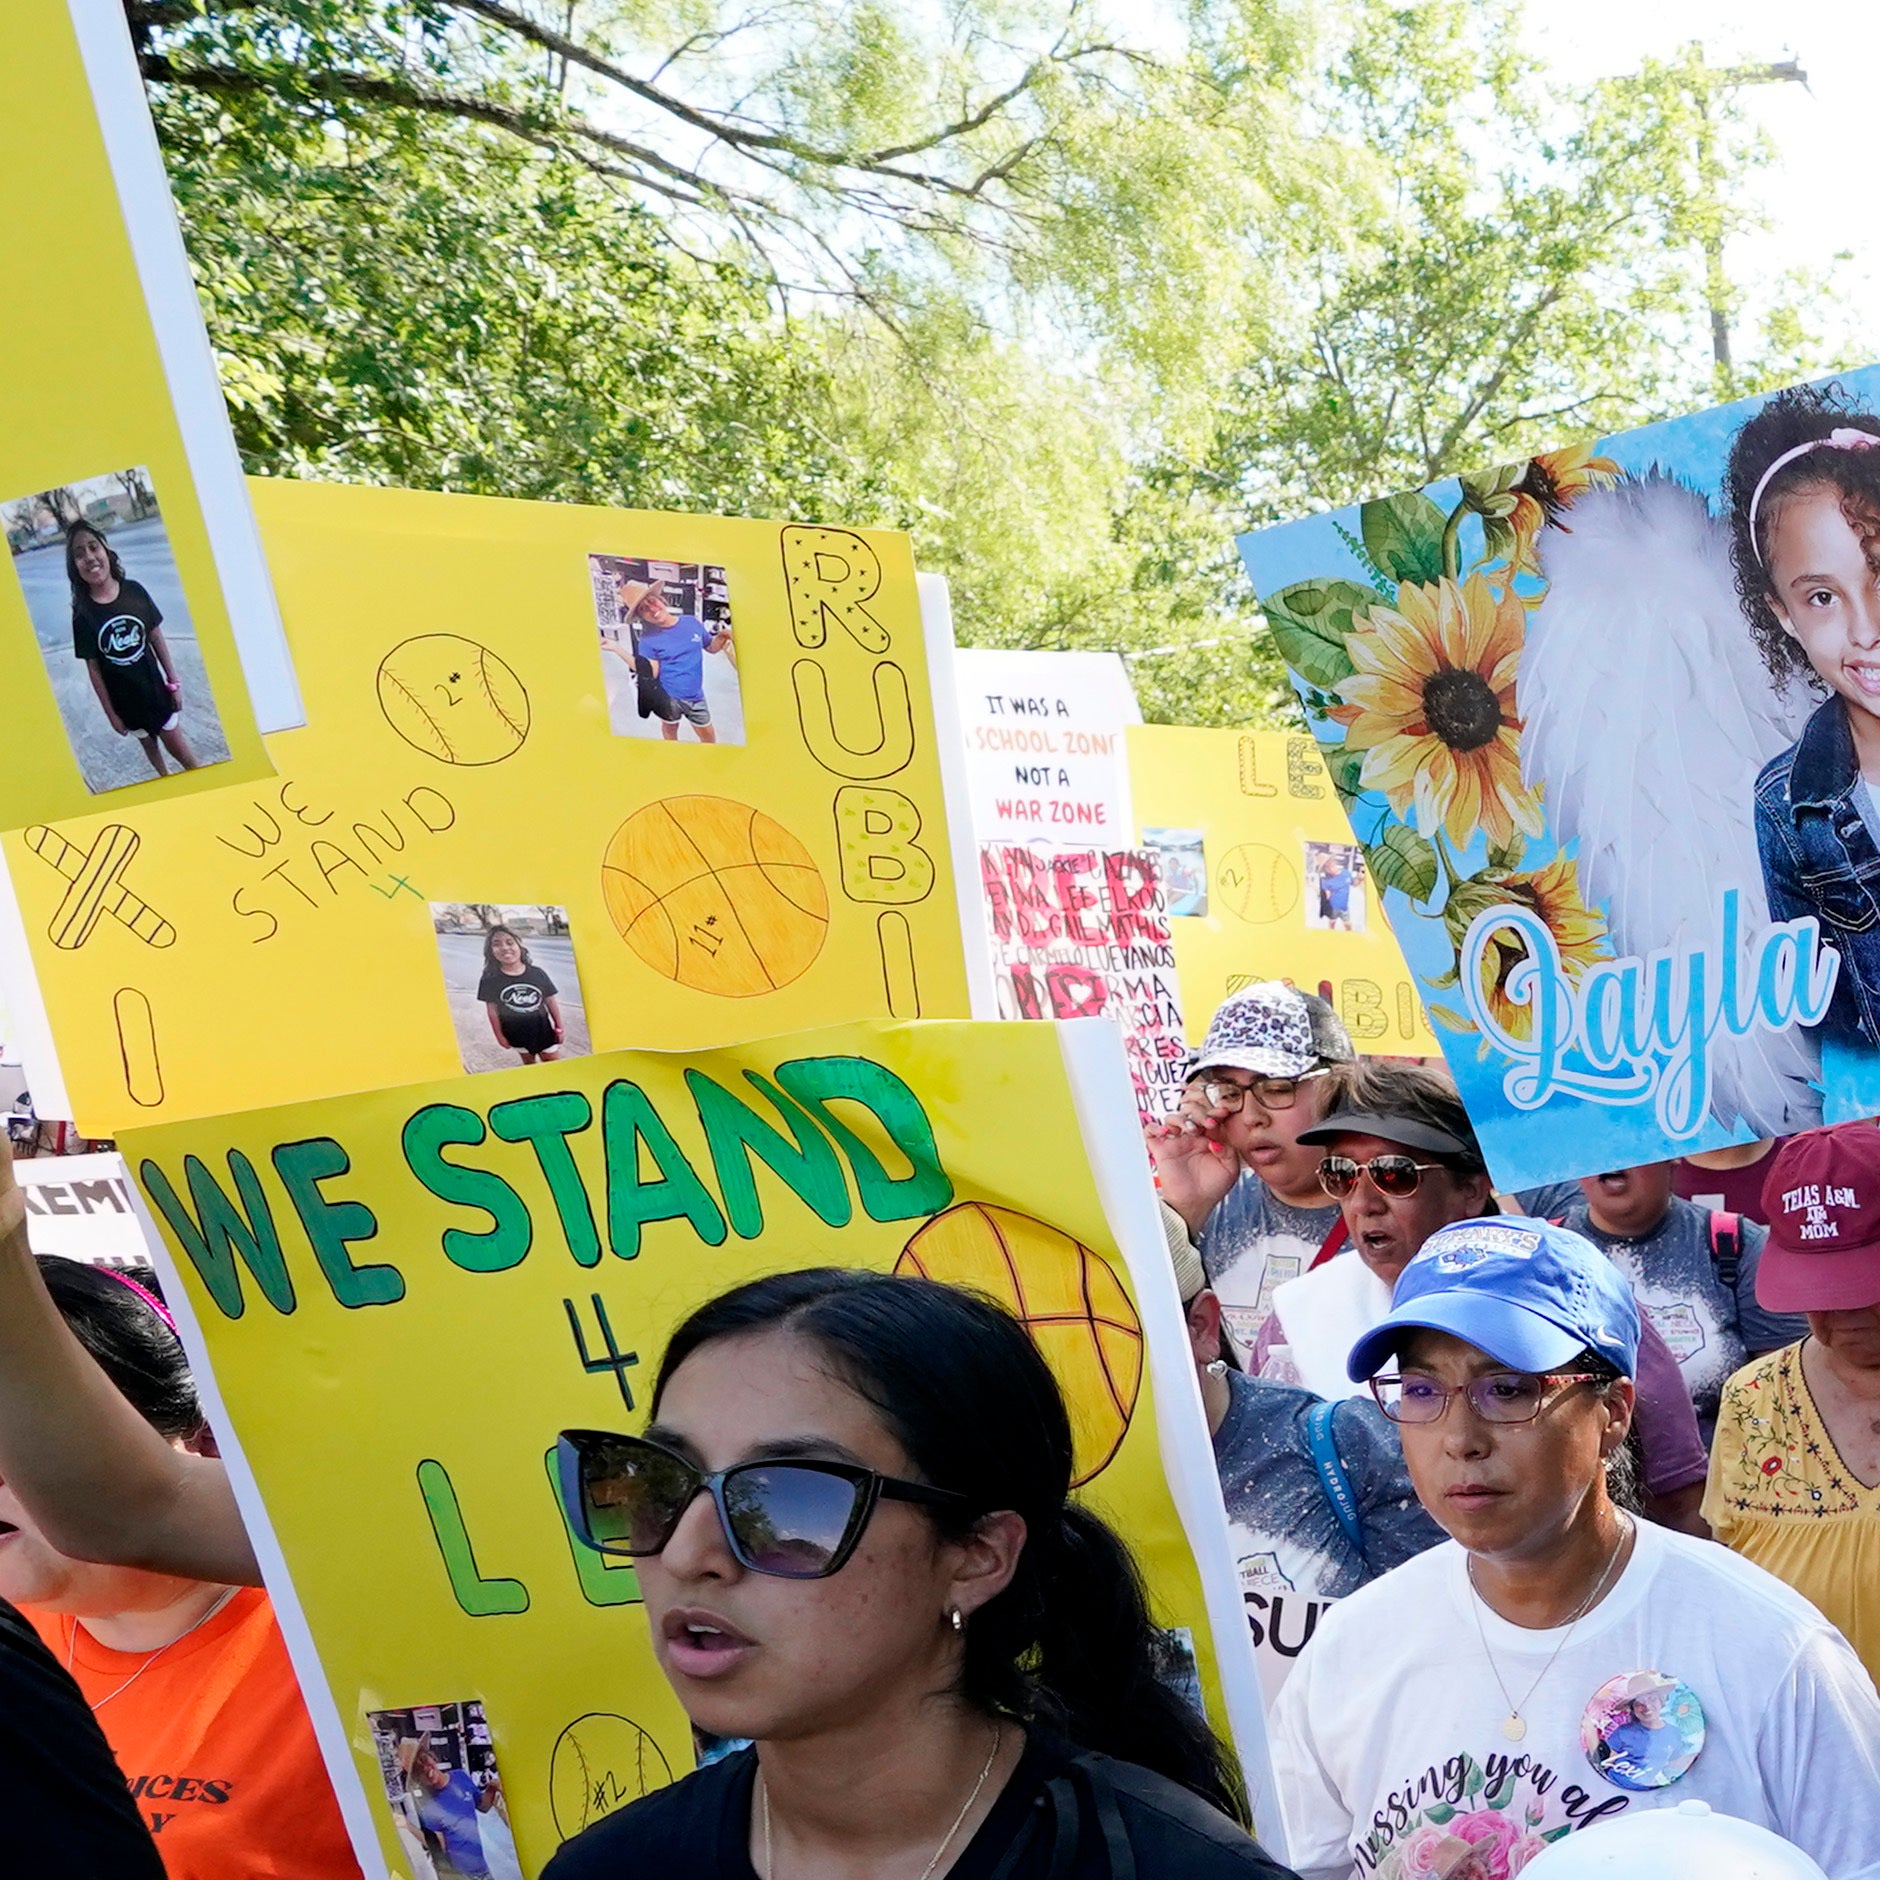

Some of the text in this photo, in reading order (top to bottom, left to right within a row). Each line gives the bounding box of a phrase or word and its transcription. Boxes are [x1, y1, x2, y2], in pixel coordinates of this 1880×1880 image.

[985, 695, 1069, 717] IT WAS A
[976, 727, 1057, 753] SCHOOL
[1016, 767, 1070, 786] NOT A
[216, 782, 334, 858] WE
[996, 799, 1107, 824] WAR ZONE
[233, 787, 456, 943] STAND
[1086, 944, 1177, 973] LUEVANOS
[1459, 888, 1838, 1141] Layla
[140, 1056, 954, 1318] WE STAND
[1781, 1184, 1820, 1214] TEXAS
[1799, 1222, 1840, 1240] MOM
[562, 1293, 638, 1412] 4
[1322, 1460, 1358, 1522] HYDROJUG
[1485, 1752, 1559, 1800] you
[1600, 1750, 1651, 1780] Lexi
[592, 1770, 628, 1815] #2
